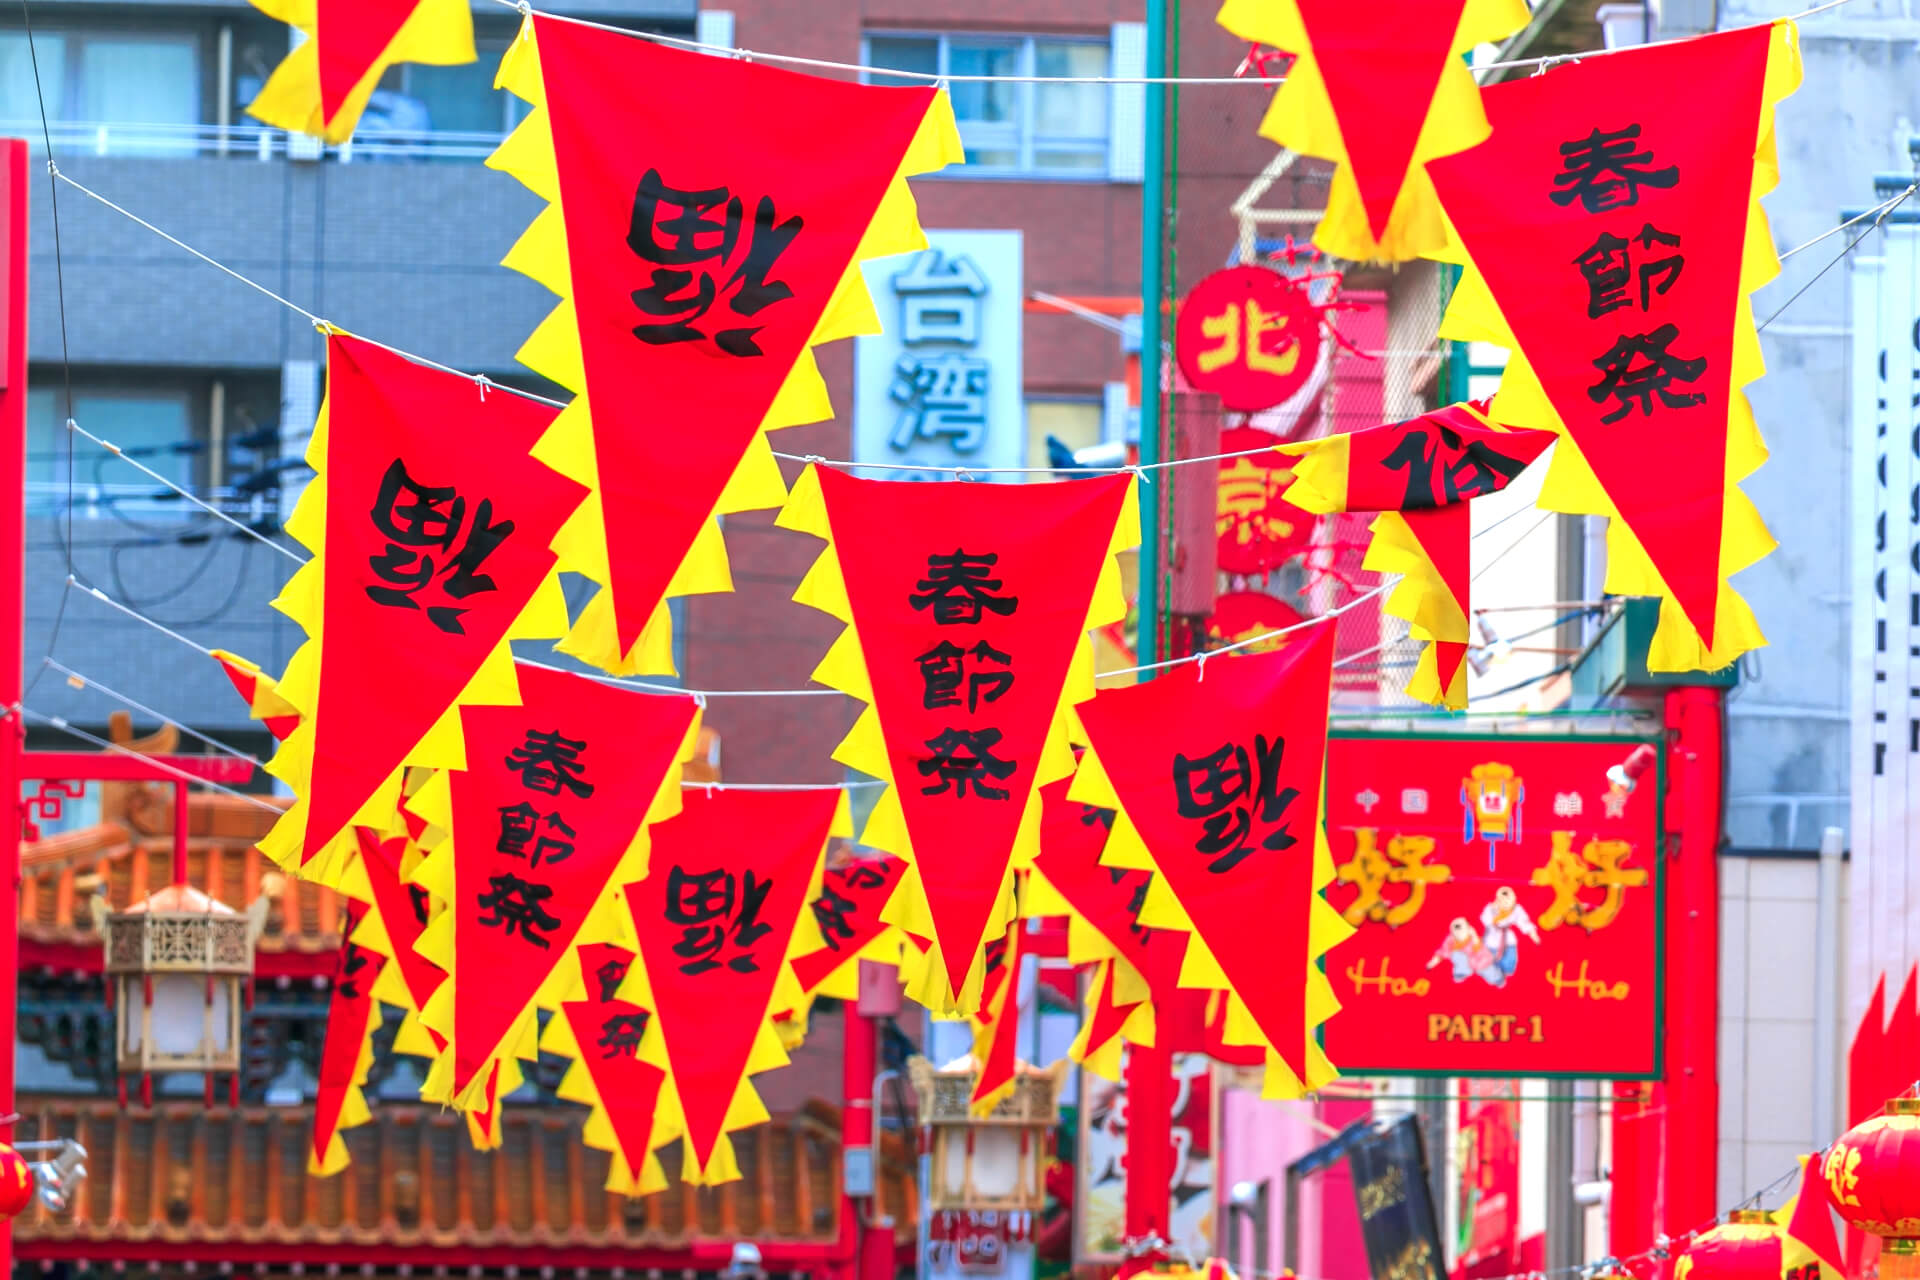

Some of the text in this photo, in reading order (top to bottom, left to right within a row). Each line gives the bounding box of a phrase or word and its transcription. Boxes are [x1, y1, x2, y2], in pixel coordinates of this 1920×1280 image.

[627, 168, 804, 357] 福
[1551, 124, 1708, 424] 春節祭
[889, 248, 990, 481] 台湾
[366, 458, 515, 635] 福
[909, 548, 1018, 801] 春節祭
[477, 729, 594, 949] 春節祭
[1173, 733, 1298, 873] 福
[1337, 827, 1648, 931] 好 好
[665, 865, 773, 974] 福
[1346, 957, 1630, 1000] Hao Hao
[1427, 1014, 1545, 1042] PART-1
